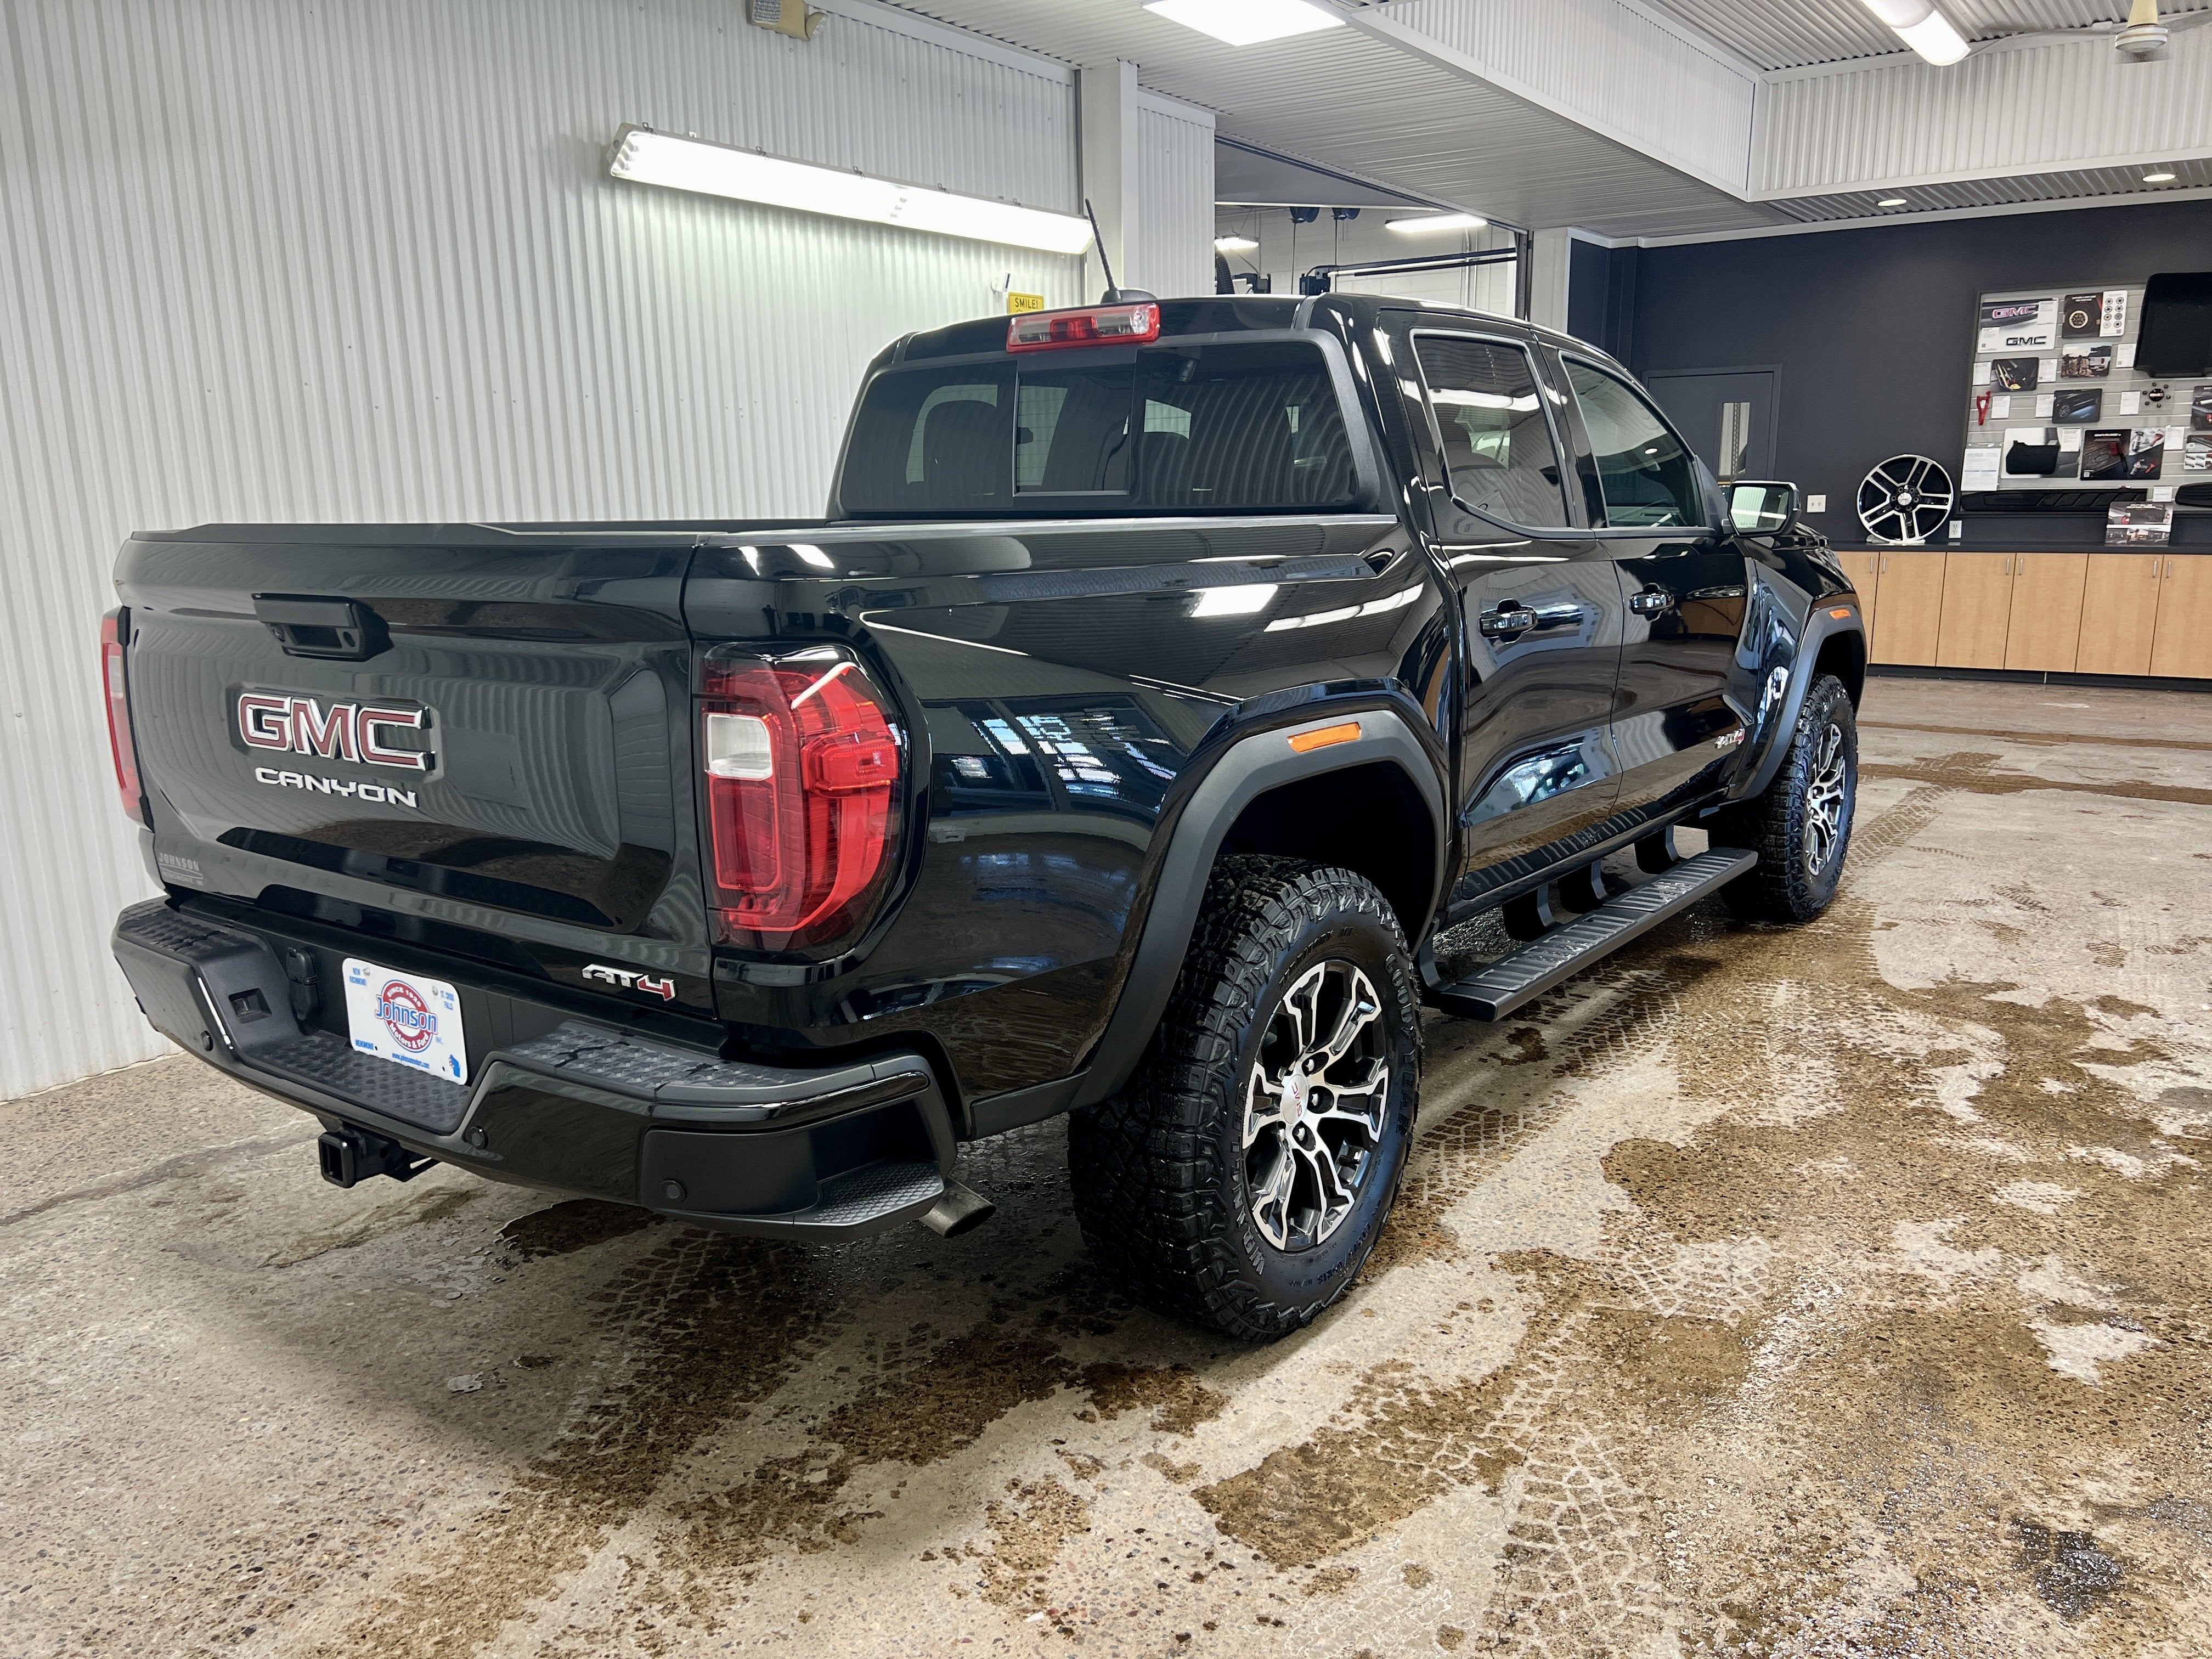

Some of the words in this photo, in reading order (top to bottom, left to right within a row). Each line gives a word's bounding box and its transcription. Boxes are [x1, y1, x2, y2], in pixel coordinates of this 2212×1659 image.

[1015, 297, 1038, 309] SMILE!
[1992, 305, 2039, 319] GMC
[2006, 336, 2047, 346] GMC
[239, 693, 432, 771] GMC
[255, 767, 417, 808] CANYON
[159, 853, 200, 872] JOHNSON
[387, 986, 404, 998] SINCE
[582, 963, 676, 1002] AT4
[376, 996, 437, 1033] Johnson
[389, 1023, 411, 1048] Motors
[411, 1040, 417, 1048] &
[417, 1031, 429, 1048] Ford
[1291, 1081, 1302, 1117] GMC
